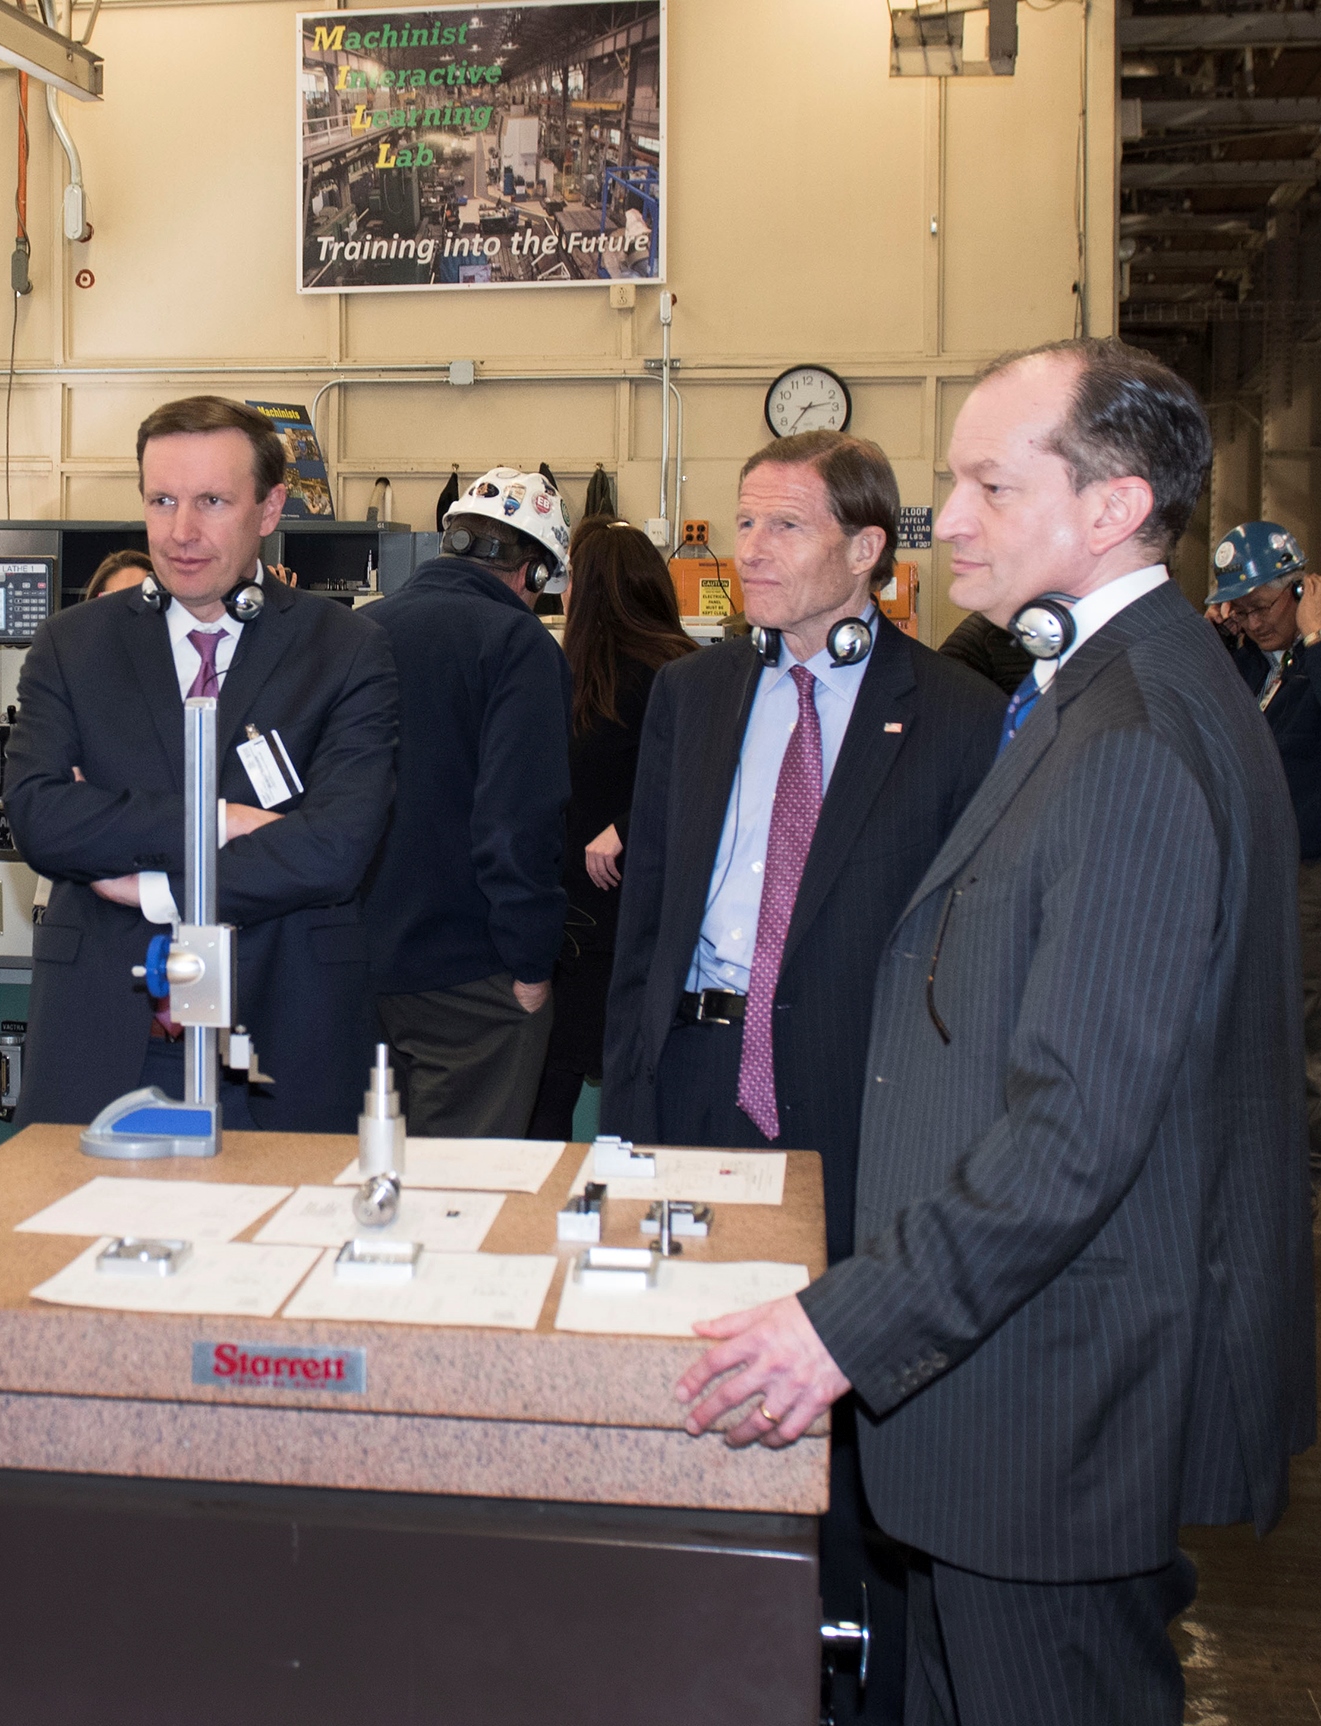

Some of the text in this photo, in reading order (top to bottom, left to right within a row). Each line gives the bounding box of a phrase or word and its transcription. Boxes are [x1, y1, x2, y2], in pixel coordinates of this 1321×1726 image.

[312, 22, 468, 51] Machinist
[334, 60, 503, 90] Interactive
[351, 102, 493, 132] Learning
[375, 142, 435, 169] Lab
[317, 229, 650, 265] Training into the Future
[791, 380, 799, 390] 11
[803, 376, 813, 385] 12
[820, 380, 823, 389] 1
[780, 390, 792, 400] 10
[828, 389, 836, 399] 2
[776, 403, 784, 413] 9
[831, 402, 839, 412] 3
[780, 416, 788, 426] 8
[828, 416, 835, 425] 4
[537, 496, 550, 509] EB
[900, 507, 927, 516] FLOOR
[212, 1343, 347, 1382] Starrett
